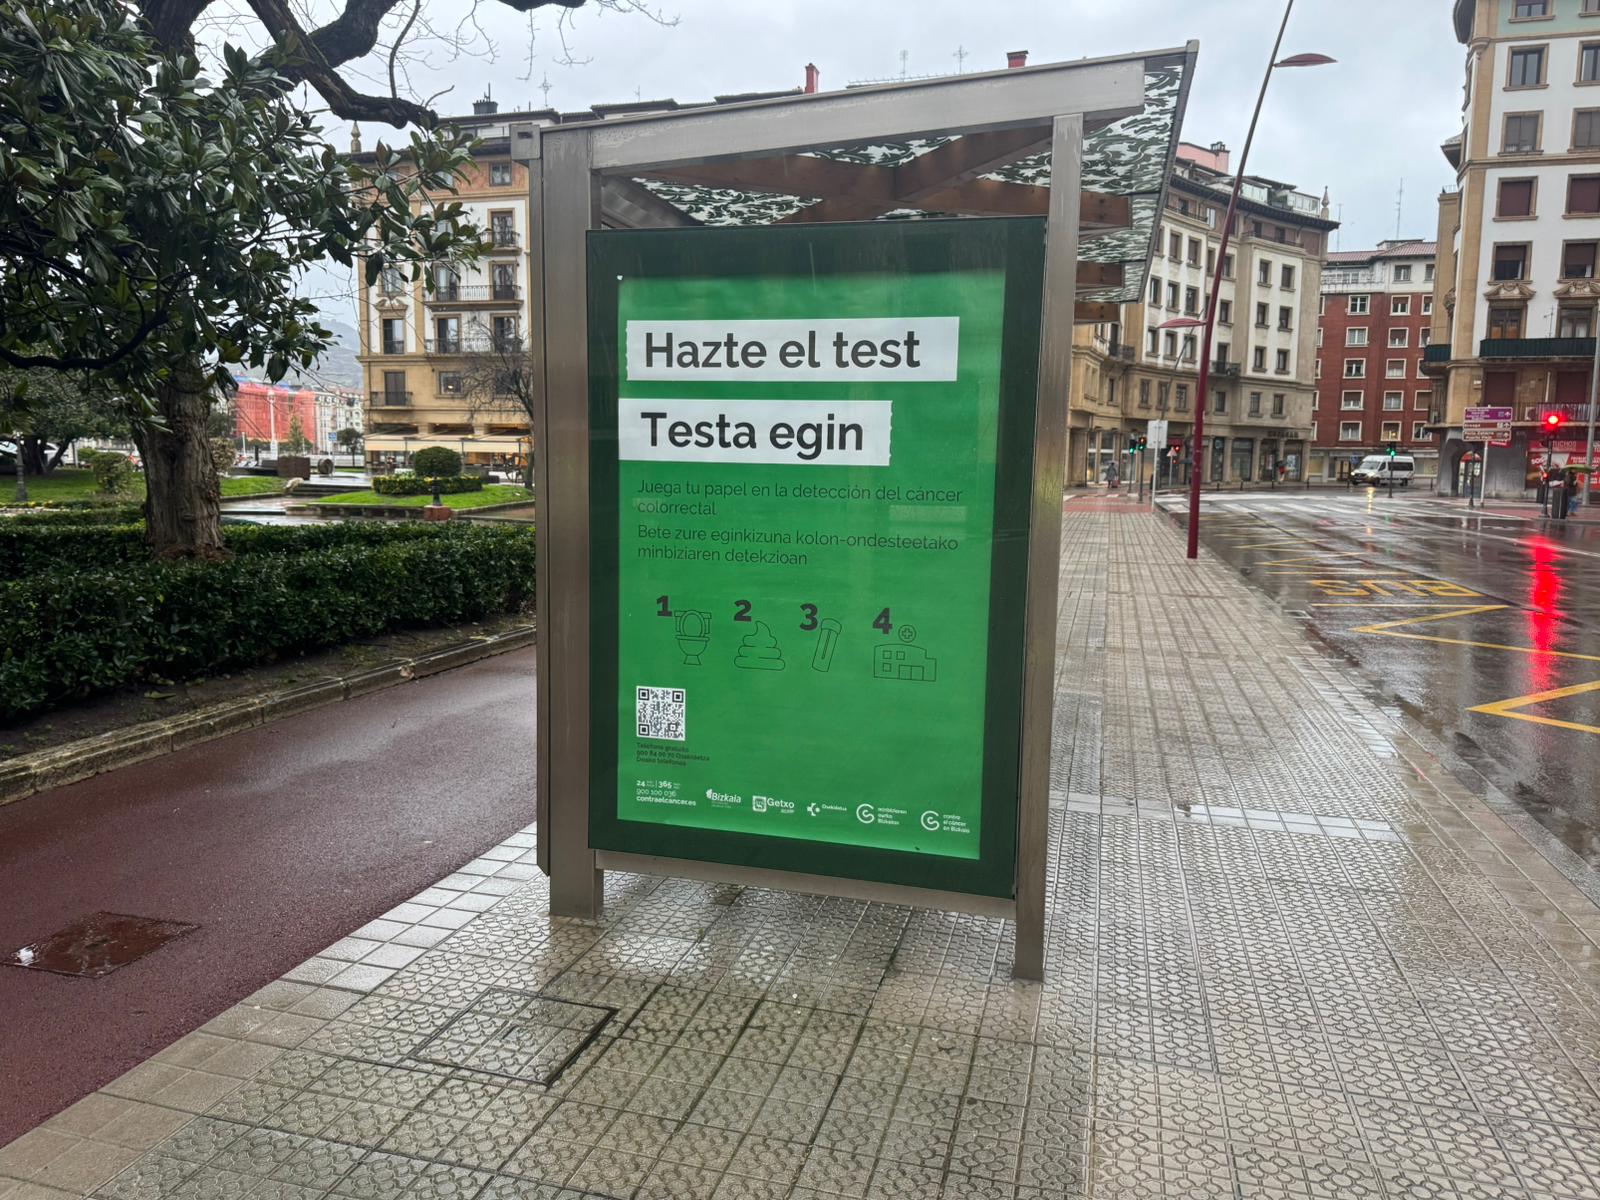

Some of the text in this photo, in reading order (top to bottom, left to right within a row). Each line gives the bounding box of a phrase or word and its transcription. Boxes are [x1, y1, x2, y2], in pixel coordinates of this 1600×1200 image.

[645, 330, 921, 369] Hazte el test
[640, 412, 864, 460] Testa egin
[637, 480, 962, 503] Juega tu papel en la detección del cáncer
[637, 501, 717, 516] colorrectal
[638, 525, 958, 551] Bete zure eginkizuna kolon-ondesteetako
[637, 545, 808, 565] minbiziaren detekzioan
[1309, 579, 1487, 597] BUS
[656, 596, 673, 617] 1
[733, 600, 752, 622] 2
[799, 603, 819, 632] 3
[872, 607, 893, 635] 4
[636, 779, 646, 787] 24
[658, 780, 673, 789] 365
[636, 788, 650, 796] 900
[711, 792, 742, 803] Bizkaia
[766, 797, 795, 809] Getxo
